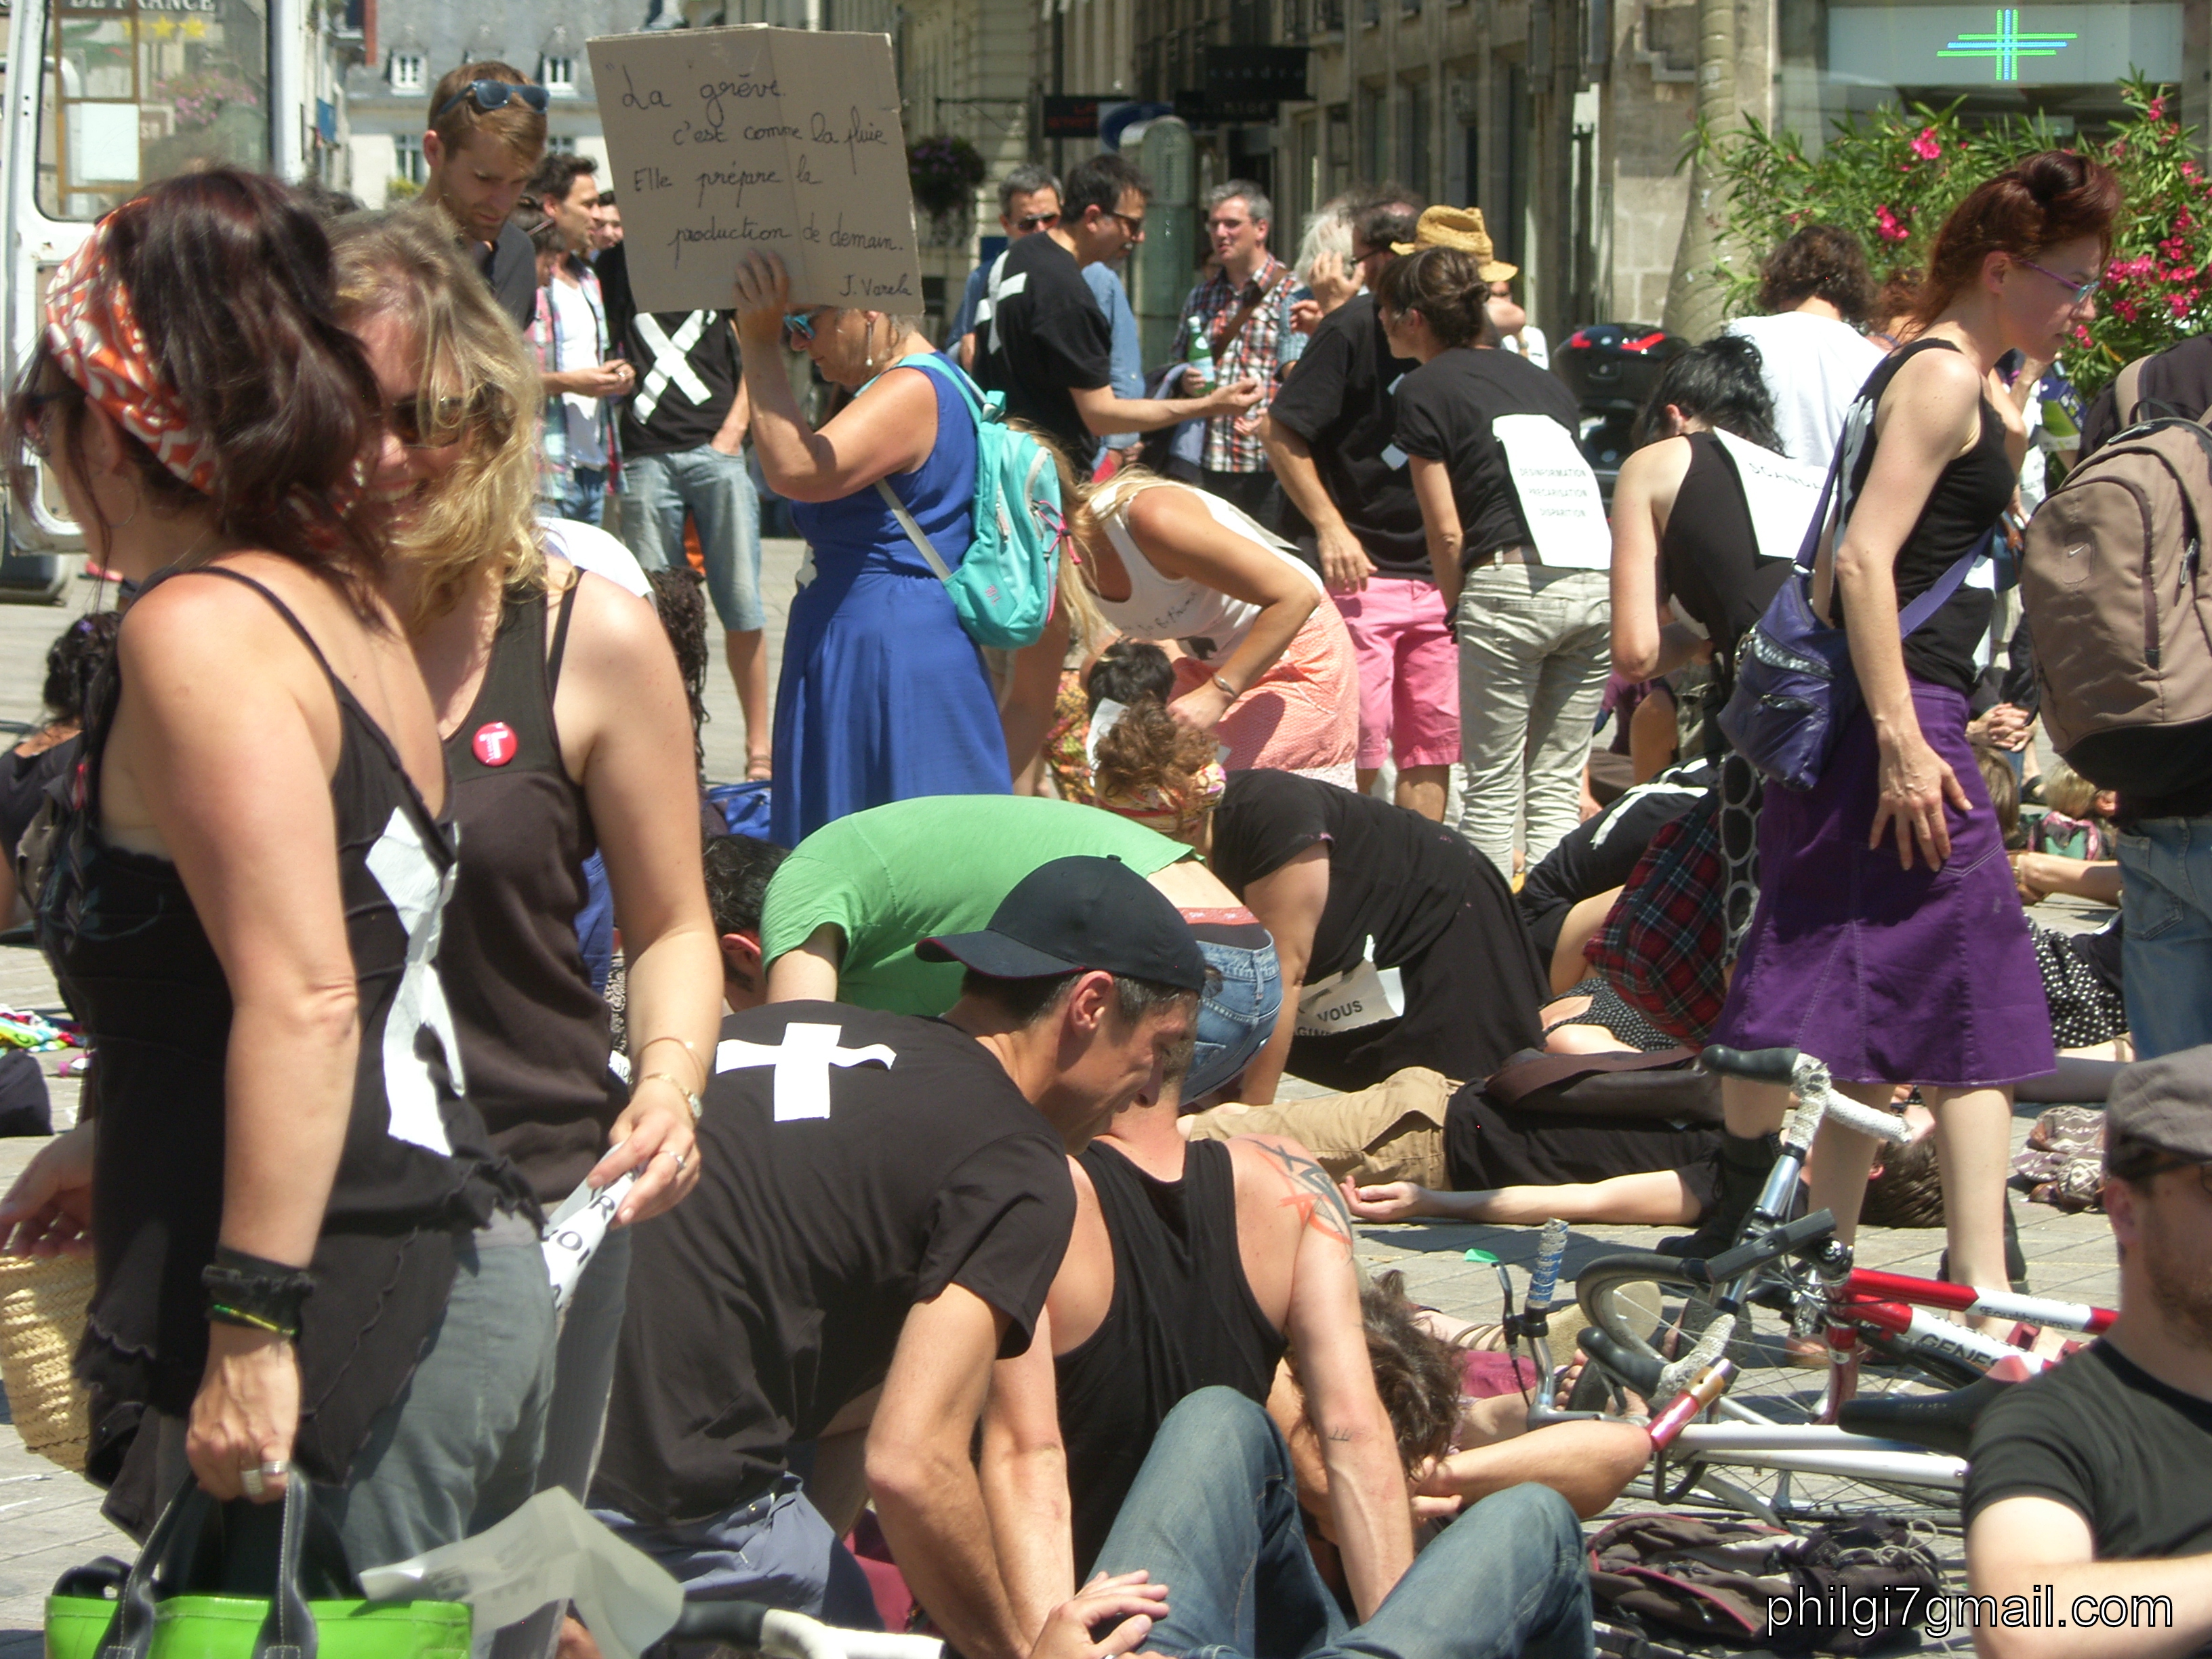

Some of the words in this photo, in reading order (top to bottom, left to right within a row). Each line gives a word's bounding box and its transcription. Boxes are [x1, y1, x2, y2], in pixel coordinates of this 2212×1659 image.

[622, 65, 672, 110] La
[673, 121, 728, 145] c'est
[743, 125, 802, 140] comme
[811, 112, 839, 144] la
[634, 167, 673, 192] Elle
[695, 160, 784, 208] prépare
[797, 154, 823, 184] la
[668, 216, 792, 270] production
[803, 211, 820, 243] de
[840, 274, 857, 296] J.
[1317, 1000, 1364, 1022] VOUS
